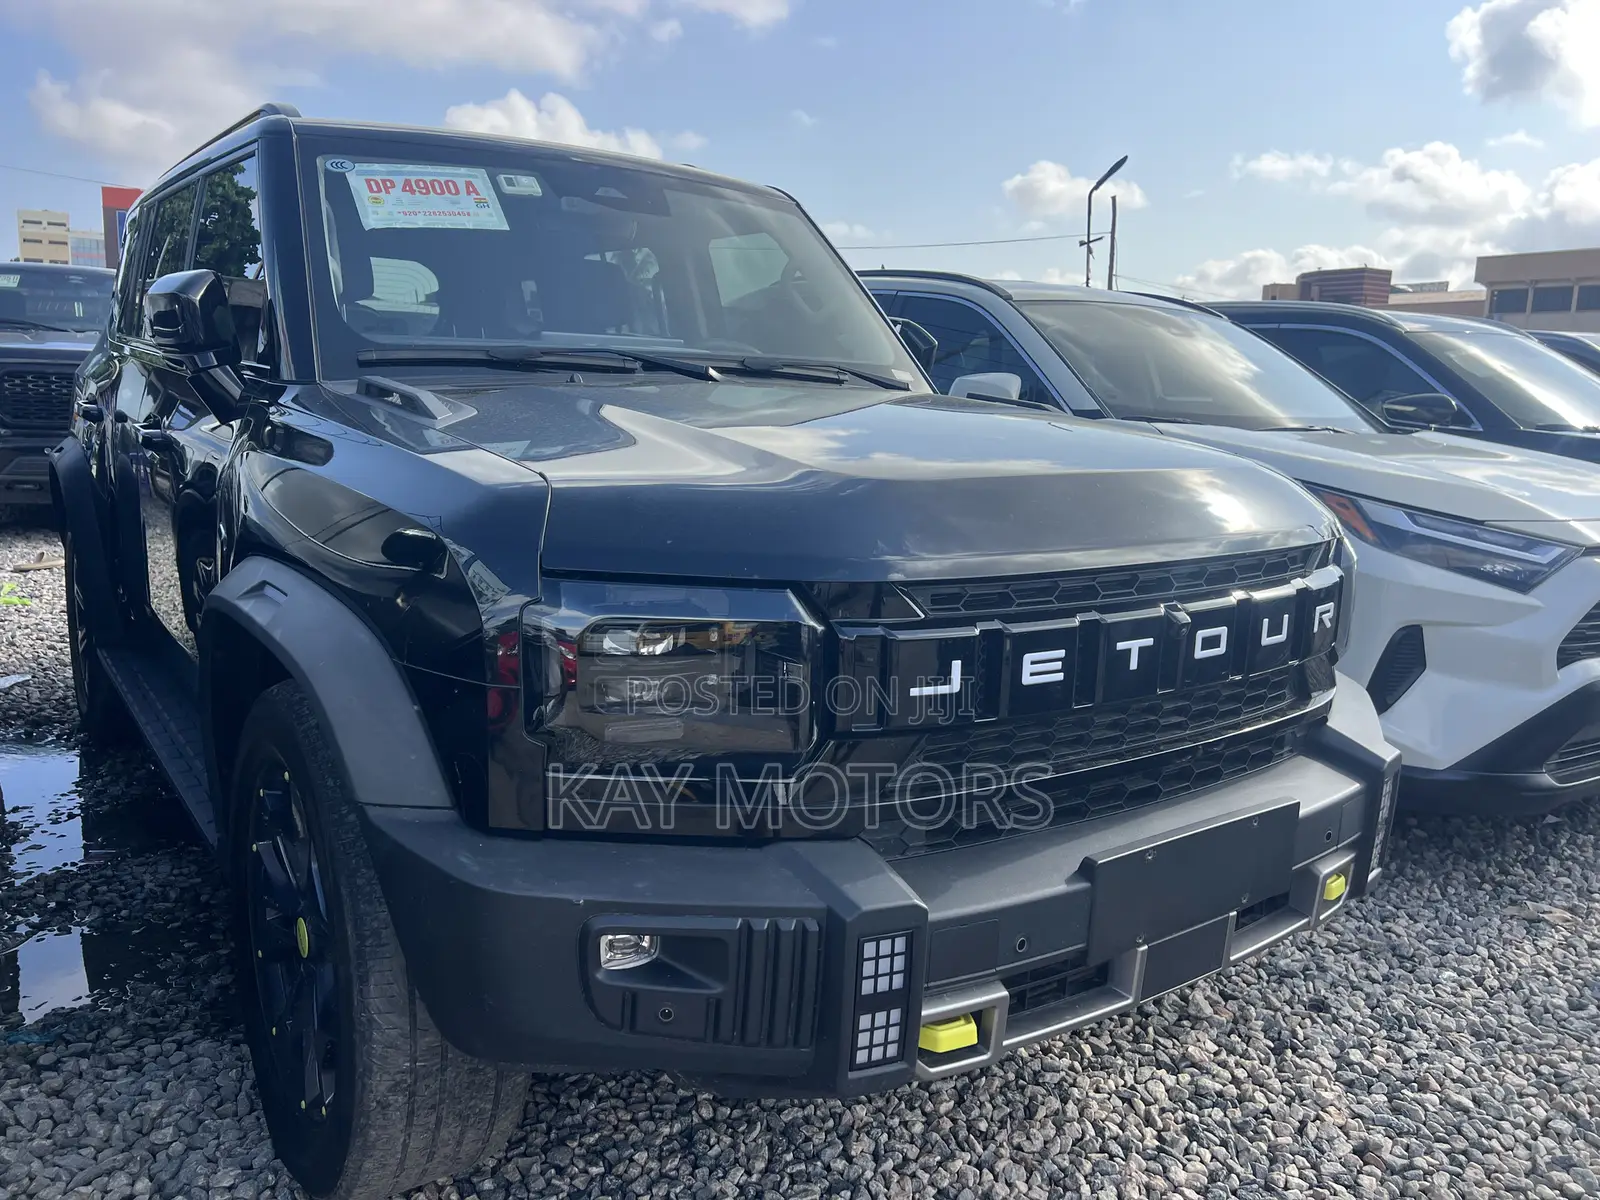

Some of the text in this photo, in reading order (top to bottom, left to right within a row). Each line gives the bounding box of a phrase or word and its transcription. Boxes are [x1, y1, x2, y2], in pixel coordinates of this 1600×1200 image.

[364, 178, 481, 197] DP 4900 A
[909, 601, 1335, 697] JETOUR
